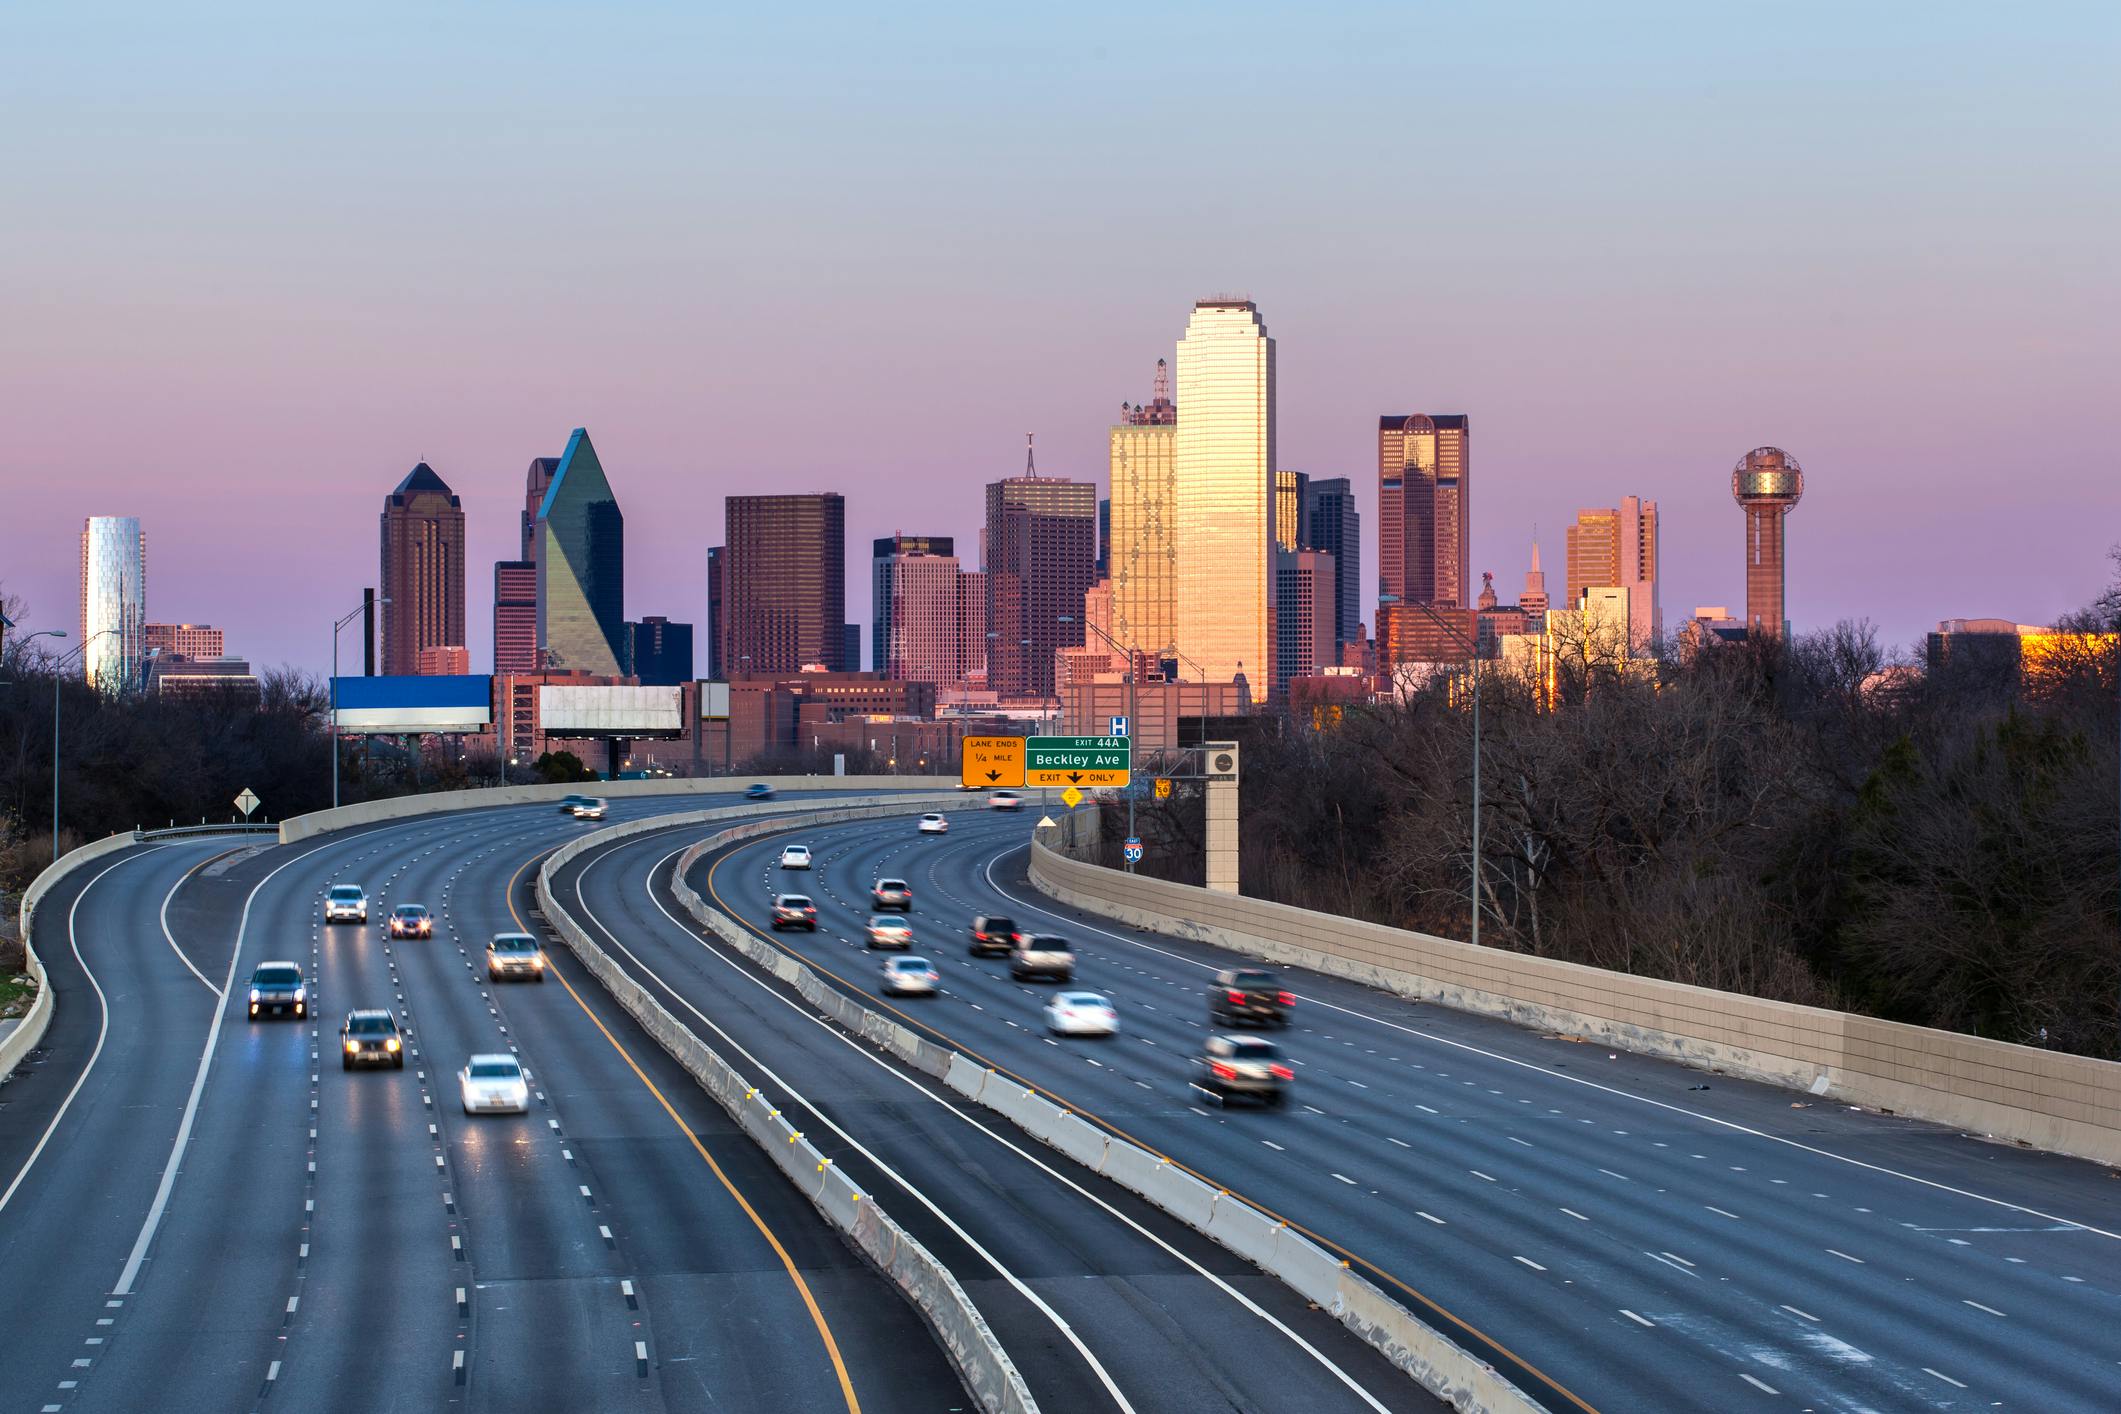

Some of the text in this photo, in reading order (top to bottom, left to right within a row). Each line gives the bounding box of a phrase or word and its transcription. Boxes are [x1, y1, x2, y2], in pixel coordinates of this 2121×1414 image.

[1112, 717, 1126, 735] H
[1097, 738, 1120, 747] 44A
[1036, 754, 1120, 767] Beckley Ave
[1039, 773, 1115, 782] EXIT ONLY
[1126, 848, 1141, 859] 30
